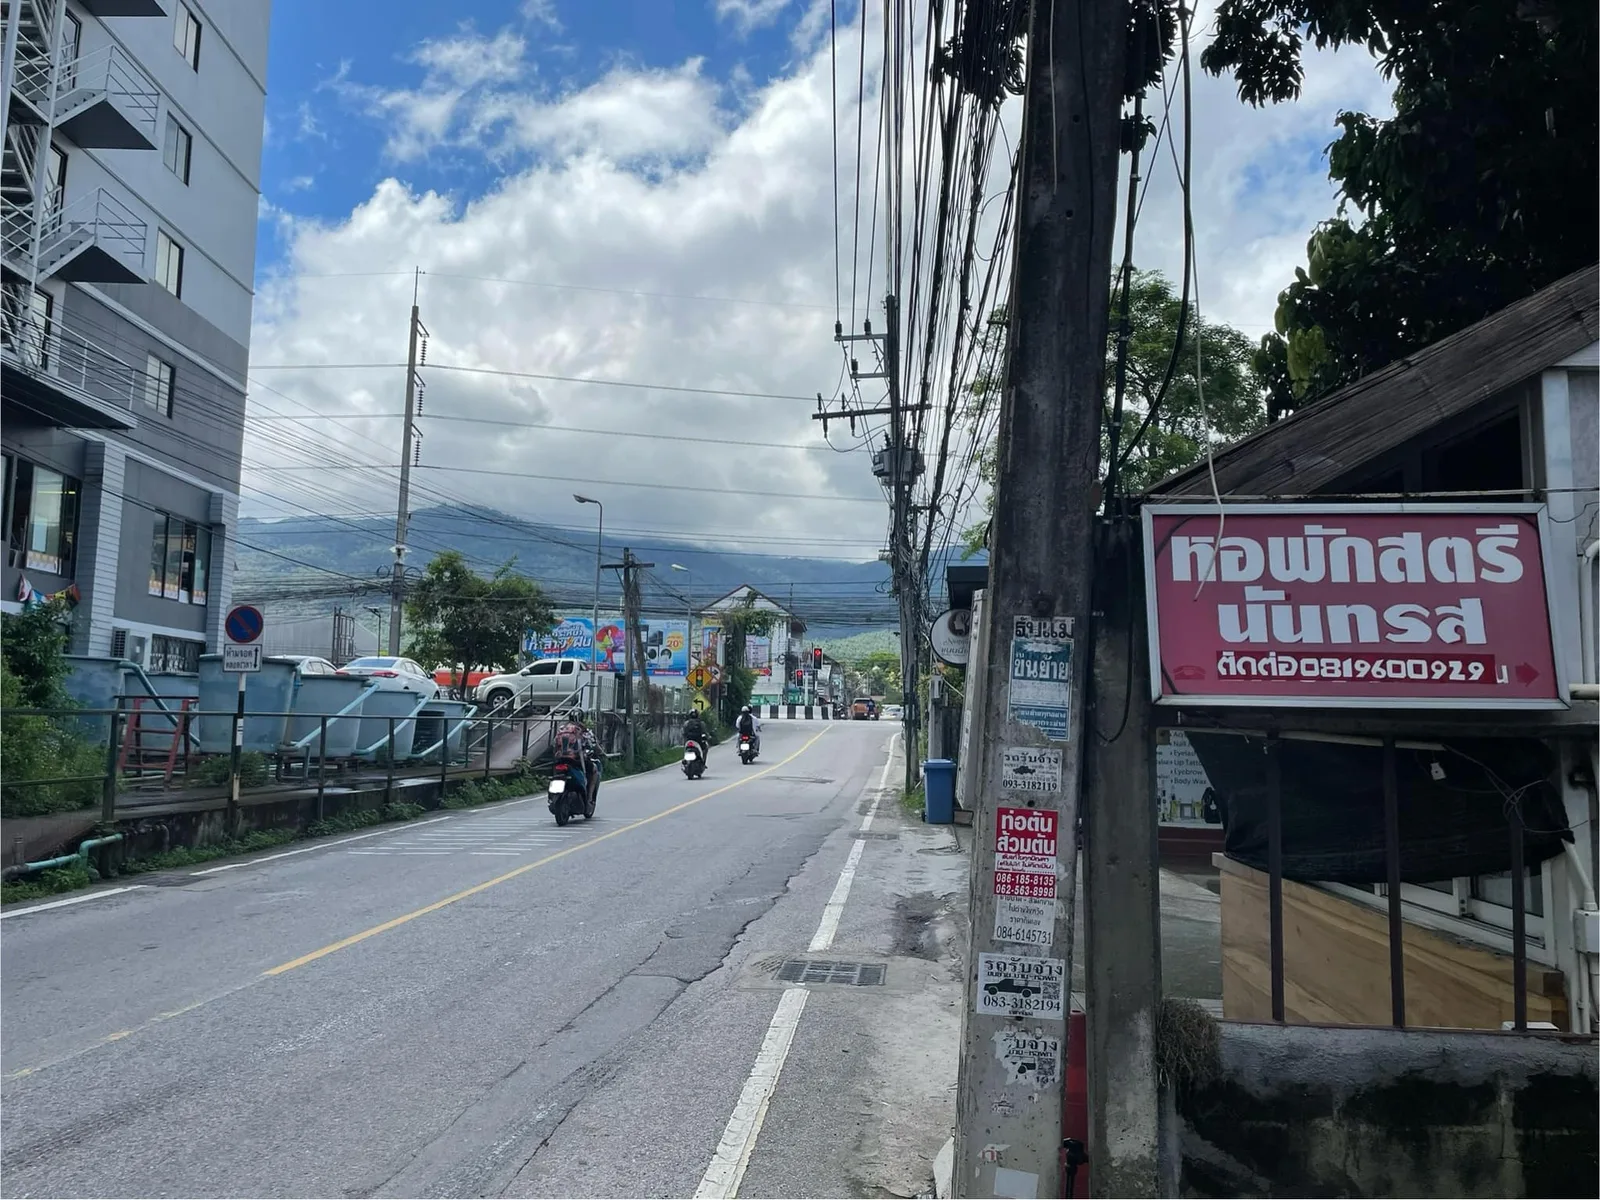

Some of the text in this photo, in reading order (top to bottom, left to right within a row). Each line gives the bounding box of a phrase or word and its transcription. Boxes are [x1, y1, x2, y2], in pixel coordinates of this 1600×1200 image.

[1171, 524, 1524, 583] หอพักสตรี
[1218, 585, 1487, 645] นันทรส
[226, 647, 253, 657] ห้ามจอด
[1003, 779, 1058, 791] 093-3182119
[1174, 778, 1191, 786] Body
[1001, 809, 1053, 832] ท่อตัน
[997, 830, 1055, 855] ส้วมตัน
[996, 873, 1054, 886] 086-185-8135
[996, 884, 1054, 897] 062-563-8998
[996, 926, 1051, 945] 084-6145731
[984, 956, 1063, 976] รถรับจ้าง
[983, 995, 1061, 1012] 083-3182194
